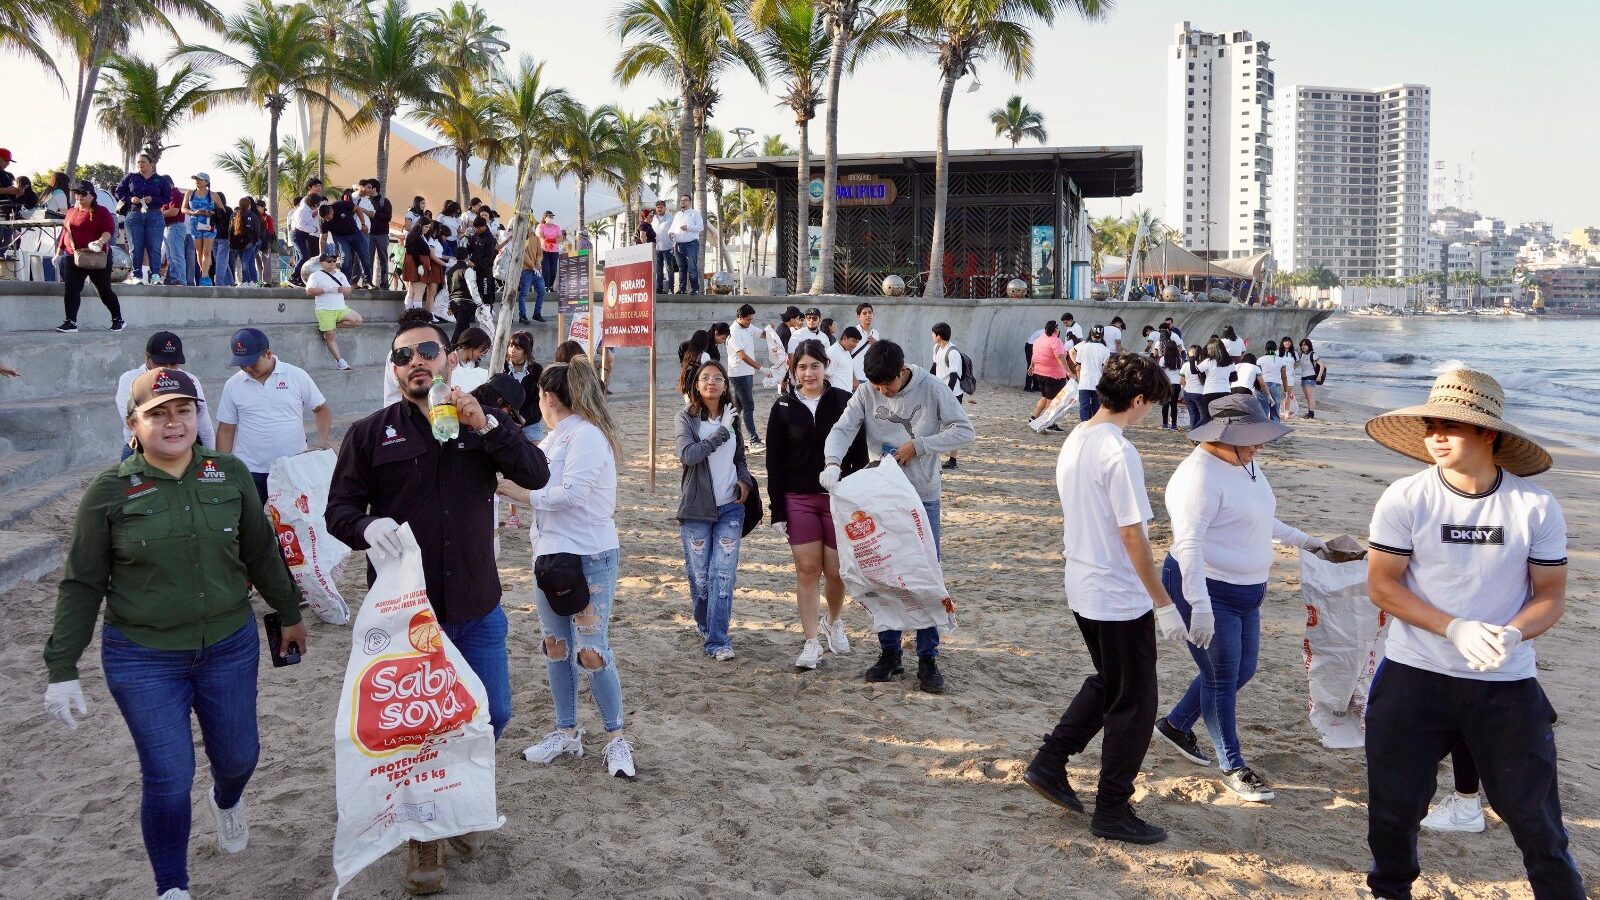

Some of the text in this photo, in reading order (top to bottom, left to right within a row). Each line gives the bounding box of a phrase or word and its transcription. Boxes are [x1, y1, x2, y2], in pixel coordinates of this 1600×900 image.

[620, 279, 645, 290] HORARIO
[618, 292, 648, 304] PERMITIDO
[618, 326, 626, 334] AM
[631, 325, 640, 334] 7:00
[641, 325, 648, 333] PM
[1450, 530, 1493, 540] DKNY
[384, 734, 422, 746] LA SOYA
[415, 768, 446, 783] 15 kg
